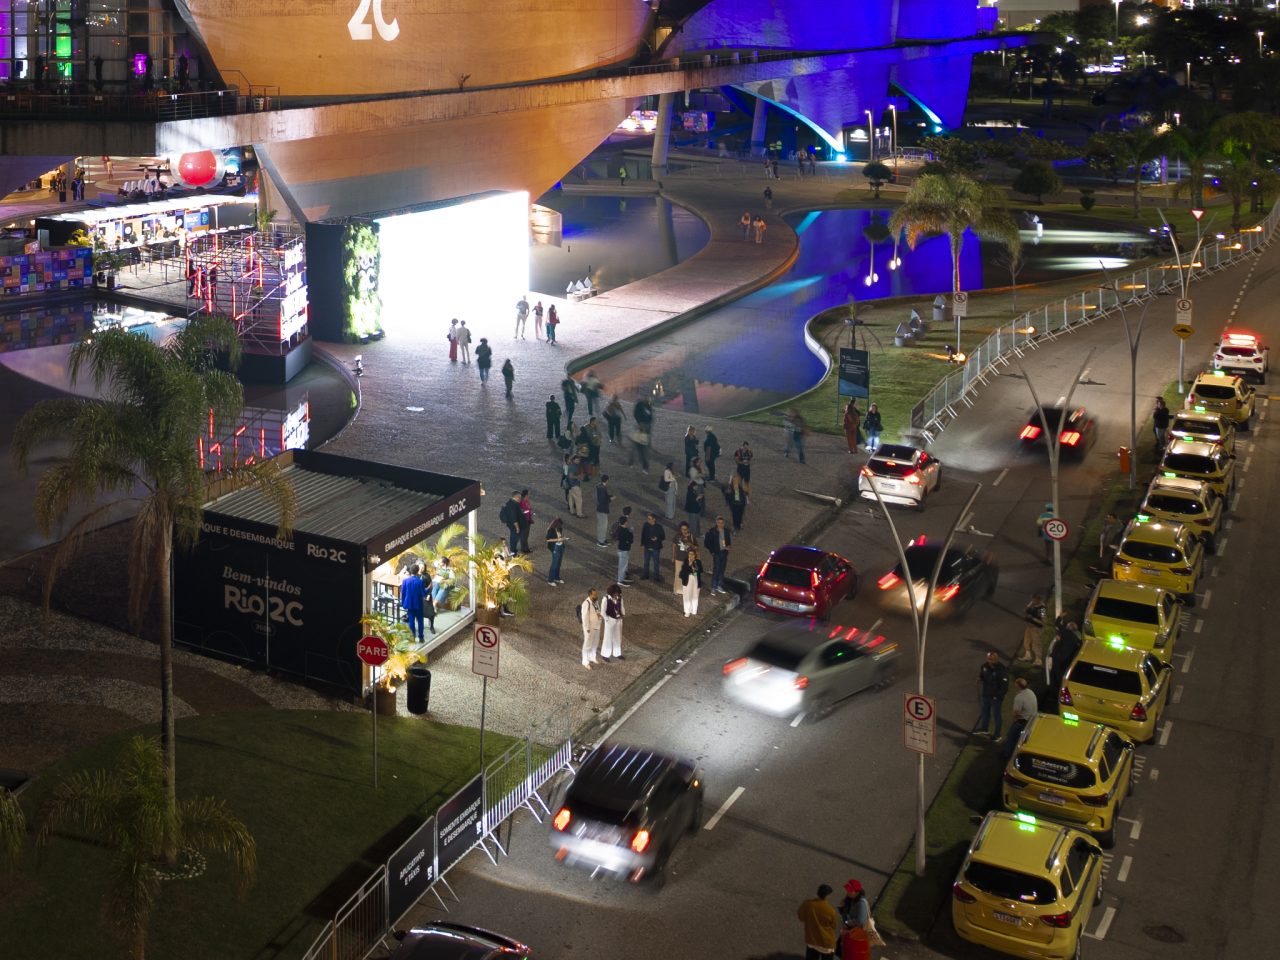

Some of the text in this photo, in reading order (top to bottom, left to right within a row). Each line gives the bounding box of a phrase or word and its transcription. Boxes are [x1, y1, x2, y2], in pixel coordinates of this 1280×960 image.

[385, 531, 410, 552] EMBARQUE
[1049, 522, 1064, 533] 20
[222, 525, 228, 535] E
[229, 528, 295, 550] DESEMBARQUE
[307, 543, 328, 558] Rio
[329, 548, 347, 563] 2C
[222, 566, 302, 596] Bem-vindos
[224, 584, 304, 626] Rio 2C
[359, 644, 387, 657] PARE
[914, 701, 924, 716] E
[440, 816, 460, 839] SOMENTE
[459, 797, 481, 822] EMBARQUE
[447, 811, 478, 844] DESEMBARQUE
[400, 848, 425, 880] APLICATIVOS
